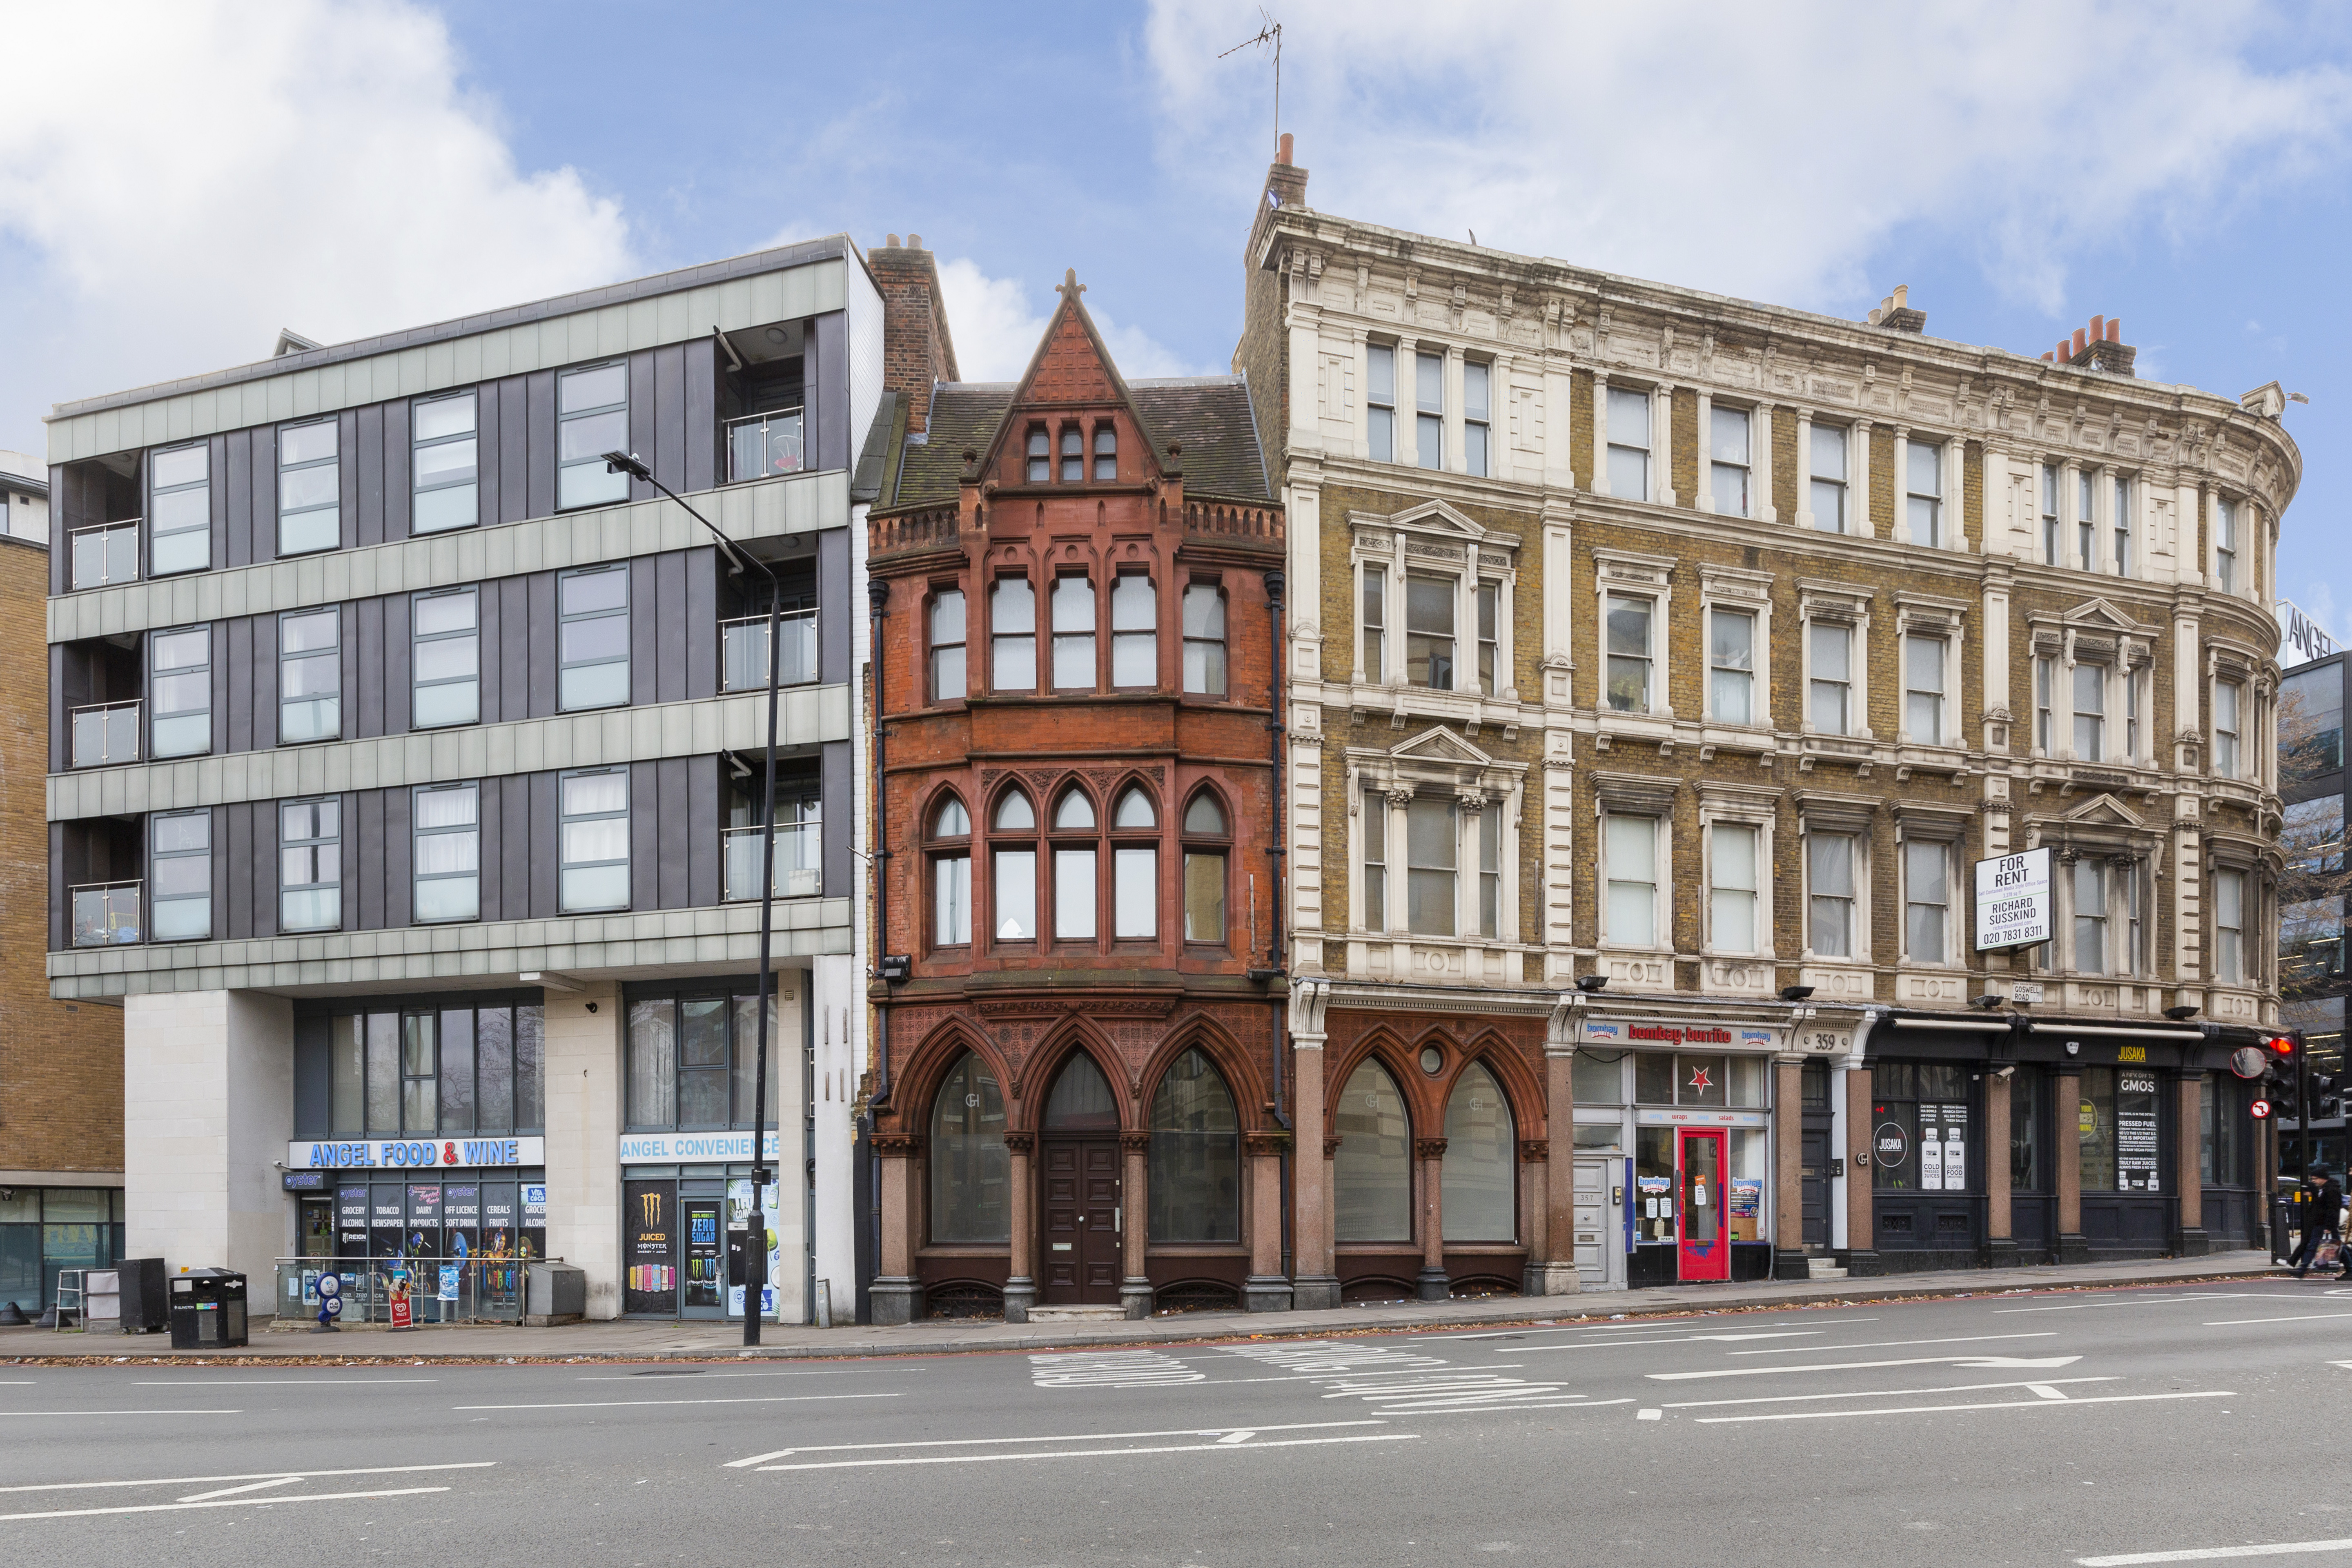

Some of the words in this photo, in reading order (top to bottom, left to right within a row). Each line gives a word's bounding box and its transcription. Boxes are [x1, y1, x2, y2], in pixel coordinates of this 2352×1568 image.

[2000, 856, 2024, 872] FOR
[1996, 869, 2029, 887] RENT
[1993, 898, 2032, 914] RICHARD
[1989, 908, 2036, 925] SUSSKIND
[1993, 920, 2032, 931] richardsusskind.com
[1984, 932, 2000, 944] 020
[2003, 929, 2020, 941] 7831
[2025, 925, 2042, 937] 8311
[1587, 1023, 1618, 1035] bombay
[1629, 1024, 1682, 1045] bombay
[1686, 1026, 1731, 1043] burrito
[1742, 1030, 1771, 1042] bombay
[1816, 1033, 1835, 1049] 359
[2118, 1046, 2146, 1060] JUSAKA
[2121, 1079, 2154, 1092] GMOS
[621, 1140, 669, 1157] ANGEL
[675, 1138, 779, 1156] CONVENIENCE
[1879, 1138, 1902, 1149] JUSAKA
[310, 1144, 375, 1166] ANGEL
[381, 1143, 436, 1166] FOOD
[443, 1142, 459, 1164] &
[464, 1140, 518, 1164] WINE
[286, 1173, 318, 1188] oyster
[1639, 1176, 1669, 1187] bombay
[1733, 1178, 1762, 1189] bombay
[340, 1188, 367, 1199] oyster
[447, 1187, 475, 1199] oyster
[342, 1206, 365, 1214] GROCERY
[376, 1206, 399, 1214] TOBACCO
[416, 1206, 432, 1214] DAIRY
[445, 1206, 455, 1214] OFF
[457, 1206, 477, 1214] LICENCE
[487, 1205, 510, 1214] CEREALS
[342, 1219, 365, 1227] ALCOHOL
[372, 1219, 403, 1227] NEWSPAPER
[489, 1218, 508, 1227] FRUITS
[692, 1219, 715, 1232] ZERO
[692, 1232, 715, 1243] SUGAR
